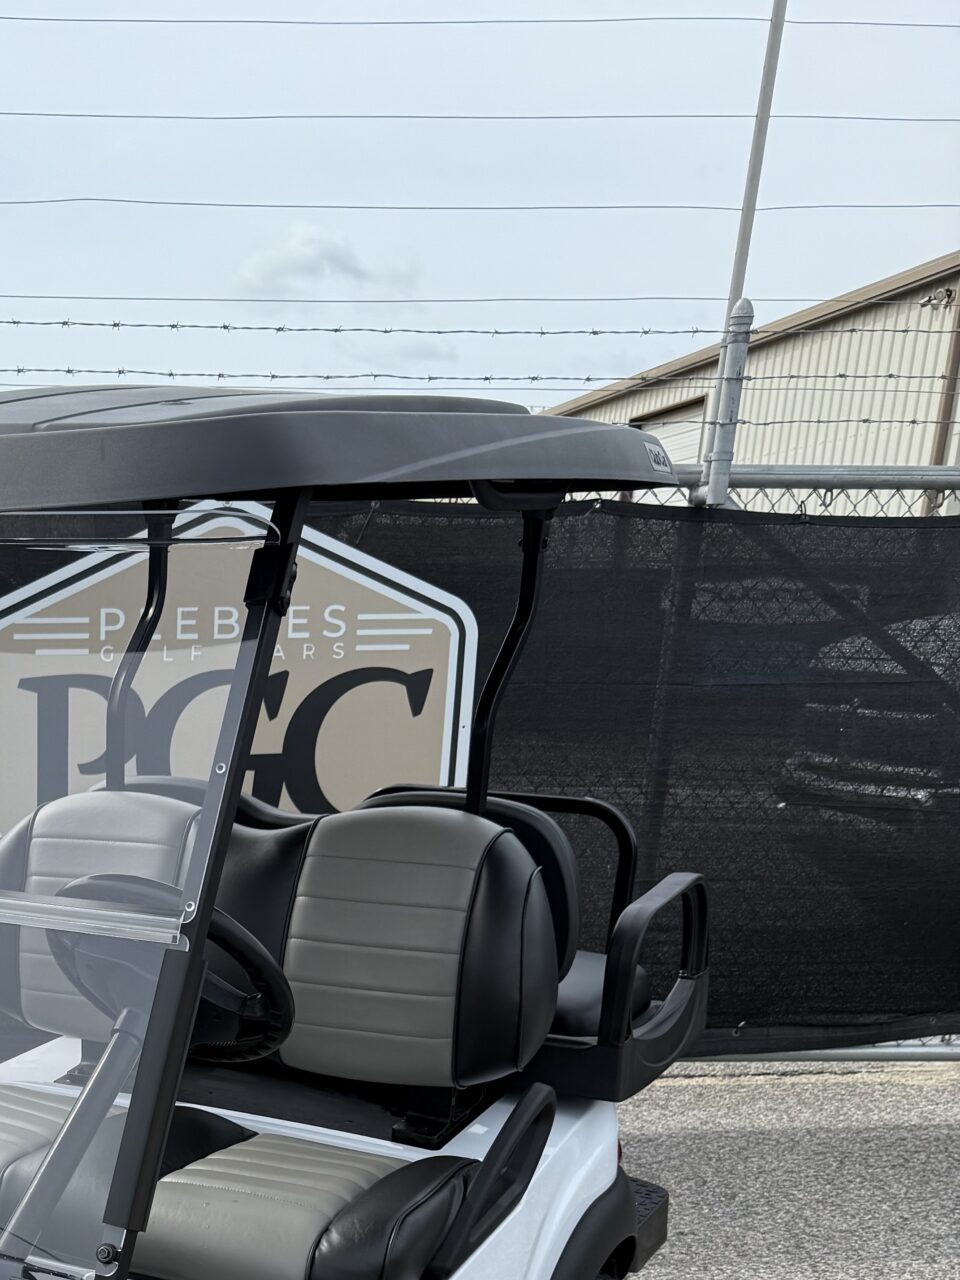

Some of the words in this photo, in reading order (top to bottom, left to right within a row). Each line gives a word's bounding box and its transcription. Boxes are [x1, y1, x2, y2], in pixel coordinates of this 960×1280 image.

[100, 604, 347, 641] PEBES
[100, 644, 202, 662] GLF
[273, 643, 345, 661] ARS
